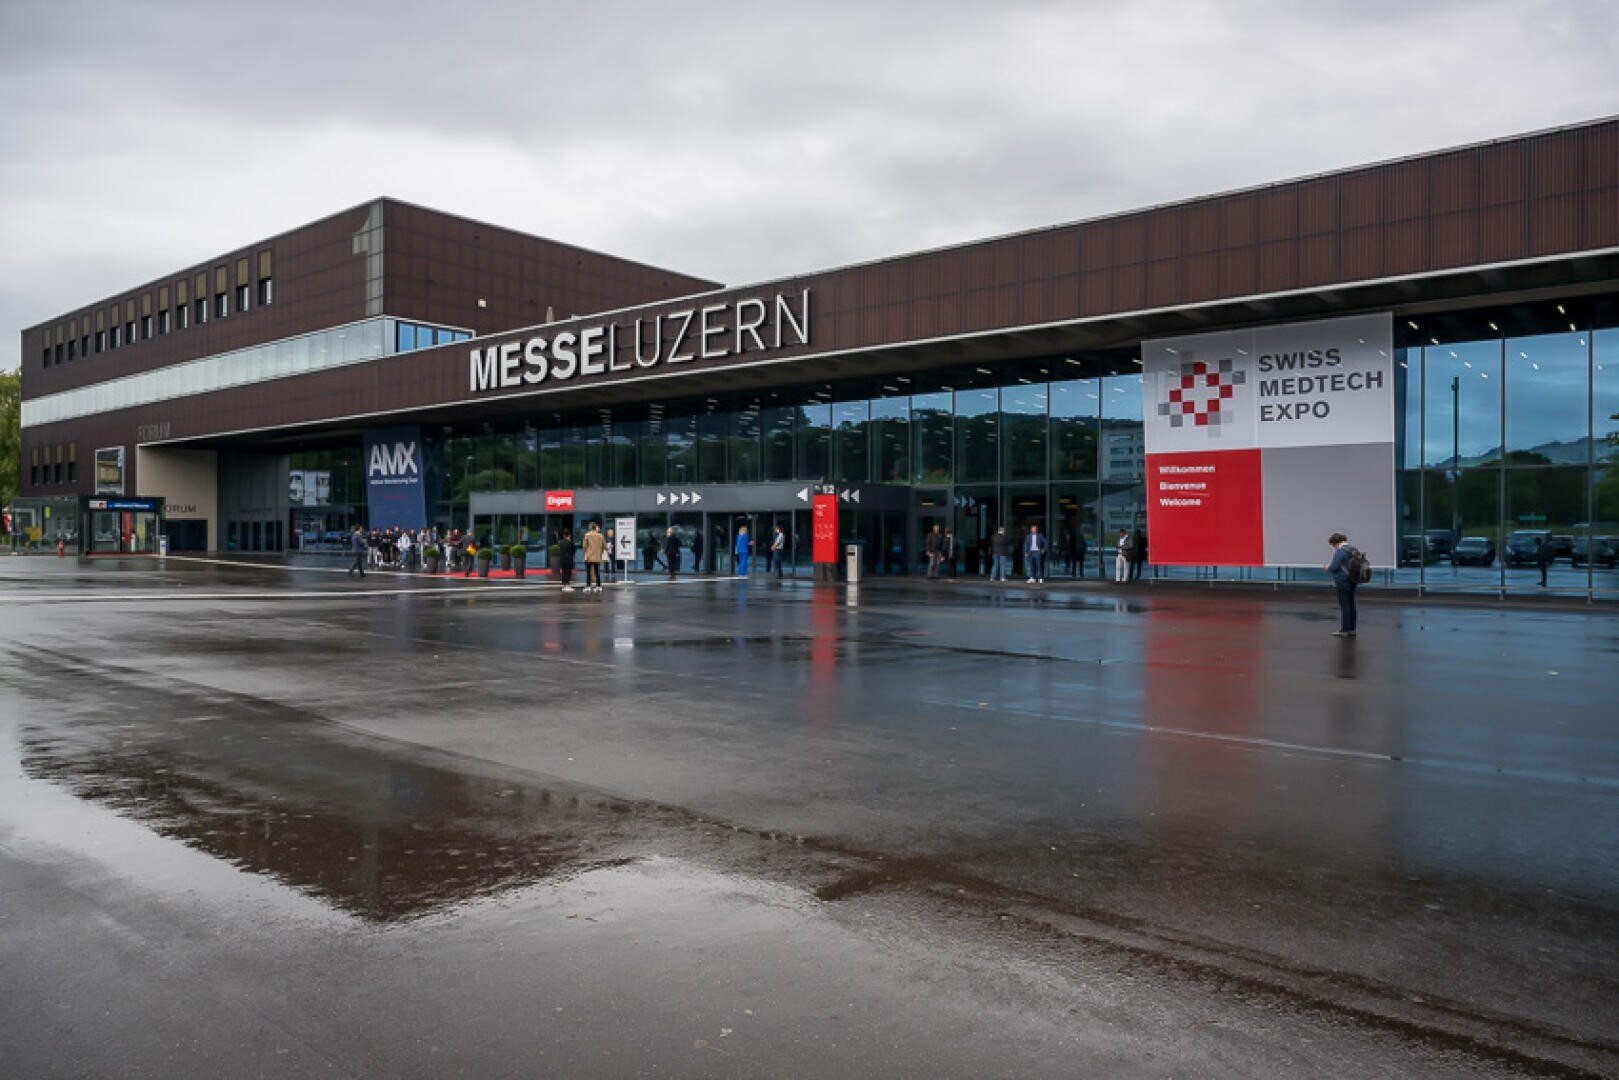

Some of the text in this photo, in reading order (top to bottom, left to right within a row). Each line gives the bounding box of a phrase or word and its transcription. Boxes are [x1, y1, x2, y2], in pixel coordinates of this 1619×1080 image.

[1258, 348, 1341, 372] SWISS
[1260, 370, 1383, 397] MEDTECH
[1260, 400, 1330, 422] EXPO
[368, 441, 418, 477] AMX
[1159, 465, 1216, 474] Willkommen
[1159, 481, 1207, 490] Bienvenue
[548, 495, 573, 508] Eingang
[1159, 498, 1202, 507] Welcome
